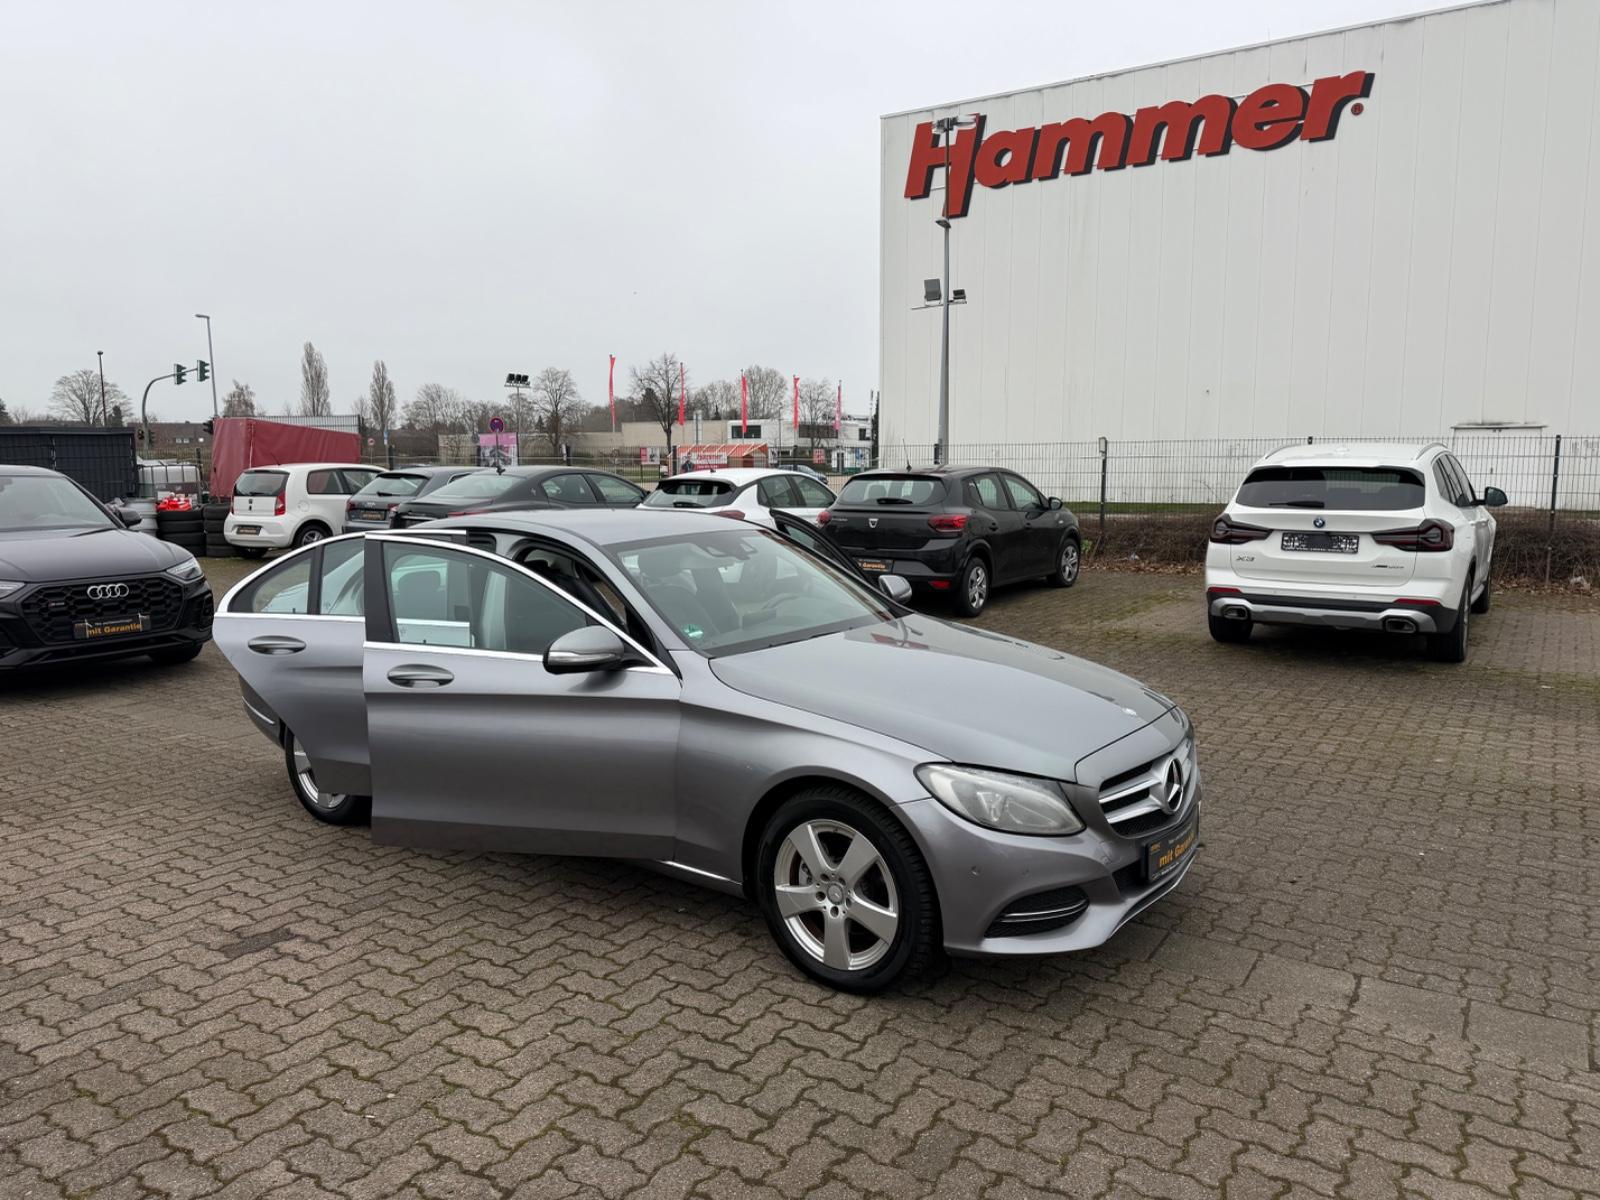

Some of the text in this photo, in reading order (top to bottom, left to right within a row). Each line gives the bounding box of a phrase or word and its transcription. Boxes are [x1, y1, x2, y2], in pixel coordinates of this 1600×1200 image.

[904, 70, 1375, 219] Hammer
[87, 625, 103, 637] mit
[104, 622, 142, 635] Garantie
[1159, 849, 1173, 867] mit
[1174, 830, 1196, 857] Garan
